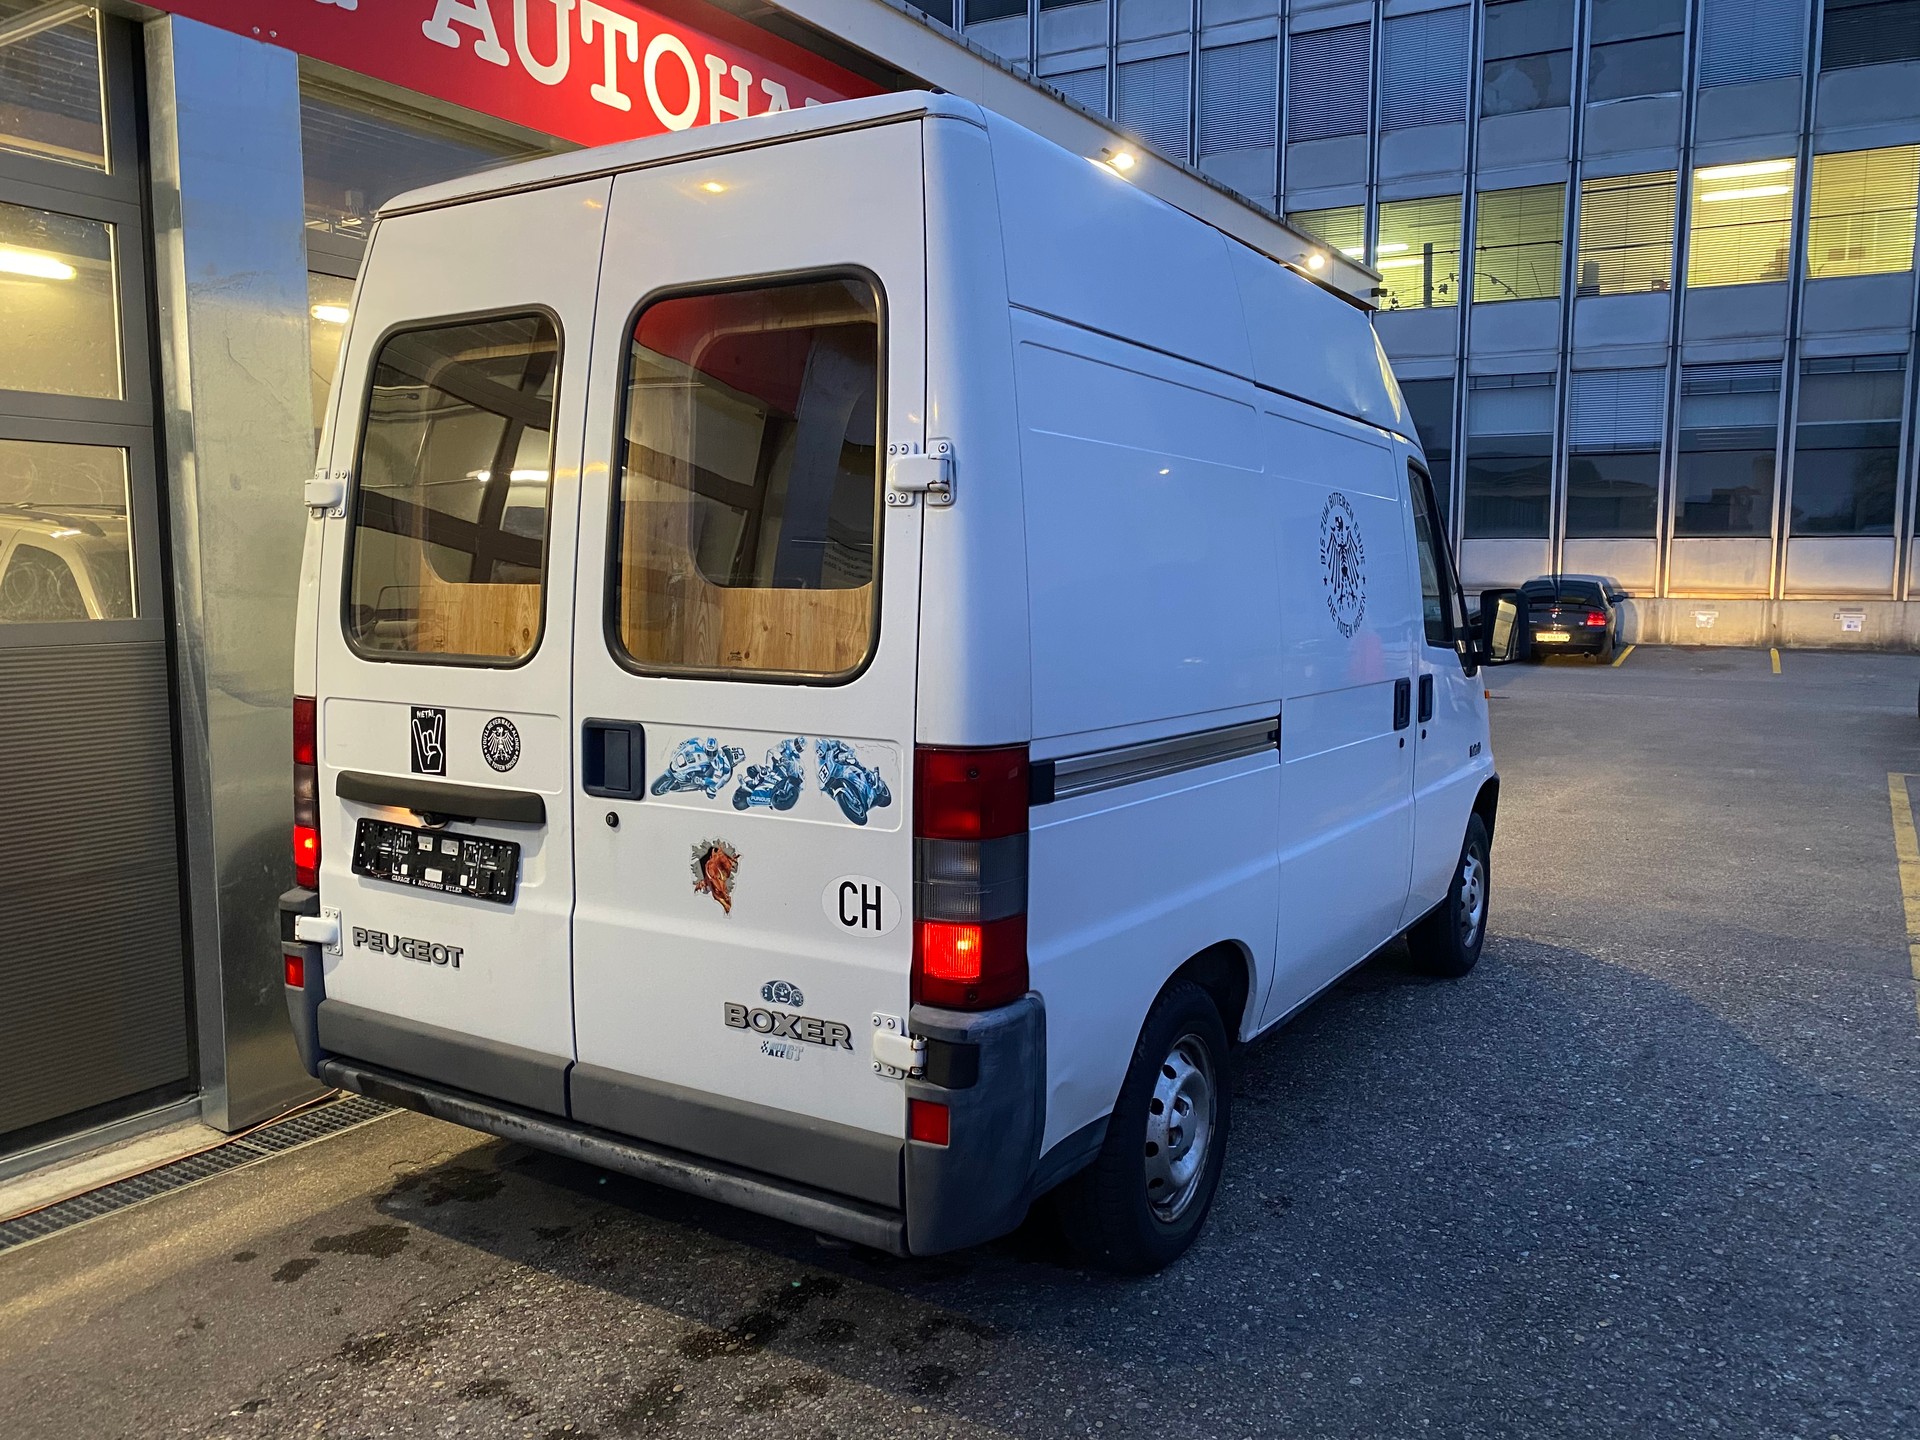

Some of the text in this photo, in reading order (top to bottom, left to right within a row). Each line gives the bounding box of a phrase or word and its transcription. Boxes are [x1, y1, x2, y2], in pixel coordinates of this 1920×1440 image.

[422, 0, 827, 131] AUTOH
[1320, 502, 1330, 536] ZUM
[1328, 492, 1354, 522] BITTEREN
[1354, 521, 1366, 565] ENDE
[1327, 591, 1366, 638] DIE TOTEN HOSEN
[416, 709, 436, 719] METAL
[501, 718, 514, 731] WALK
[511, 730, 520, 750] ALONE
[391, 874, 411, 884] GARAGE
[417, 879, 443, 890] AUTOHAUS
[838, 880, 882, 931] CH
[352, 926, 463, 968] PEUGEOT
[724, 1001, 853, 1050] BOXER
